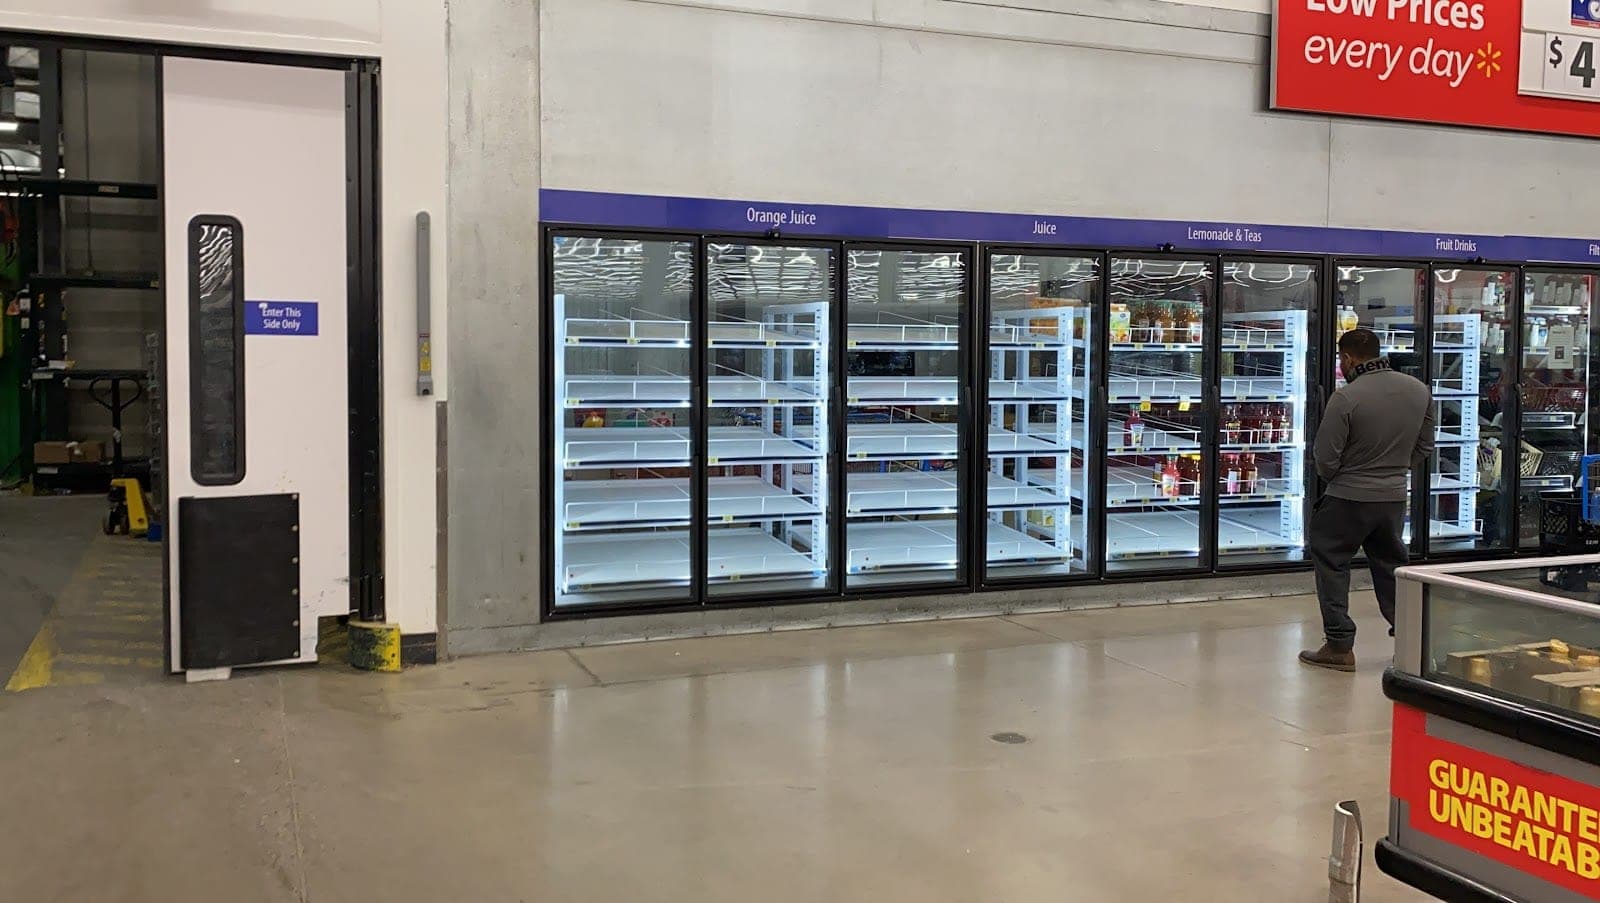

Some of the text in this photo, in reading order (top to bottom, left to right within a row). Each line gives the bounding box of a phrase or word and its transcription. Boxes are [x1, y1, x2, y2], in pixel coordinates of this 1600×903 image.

[1387, 0, 1485, 31] Prices
[1304, 35, 1474, 88] every day
[746, 207, 817, 227] Orange Juice
[1032, 219, 1057, 235] Juice
[1188, 226, 1262, 242] Lemonade & Teas
[1435, 238, 1477, 252] Fruit Drinks
[262, 307, 302, 317] Enter This
[263, 319, 301, 331] Side Only
[1429, 759, 1600, 844] GUARANTE
[1429, 788, 1600, 880] UNBEATAB
